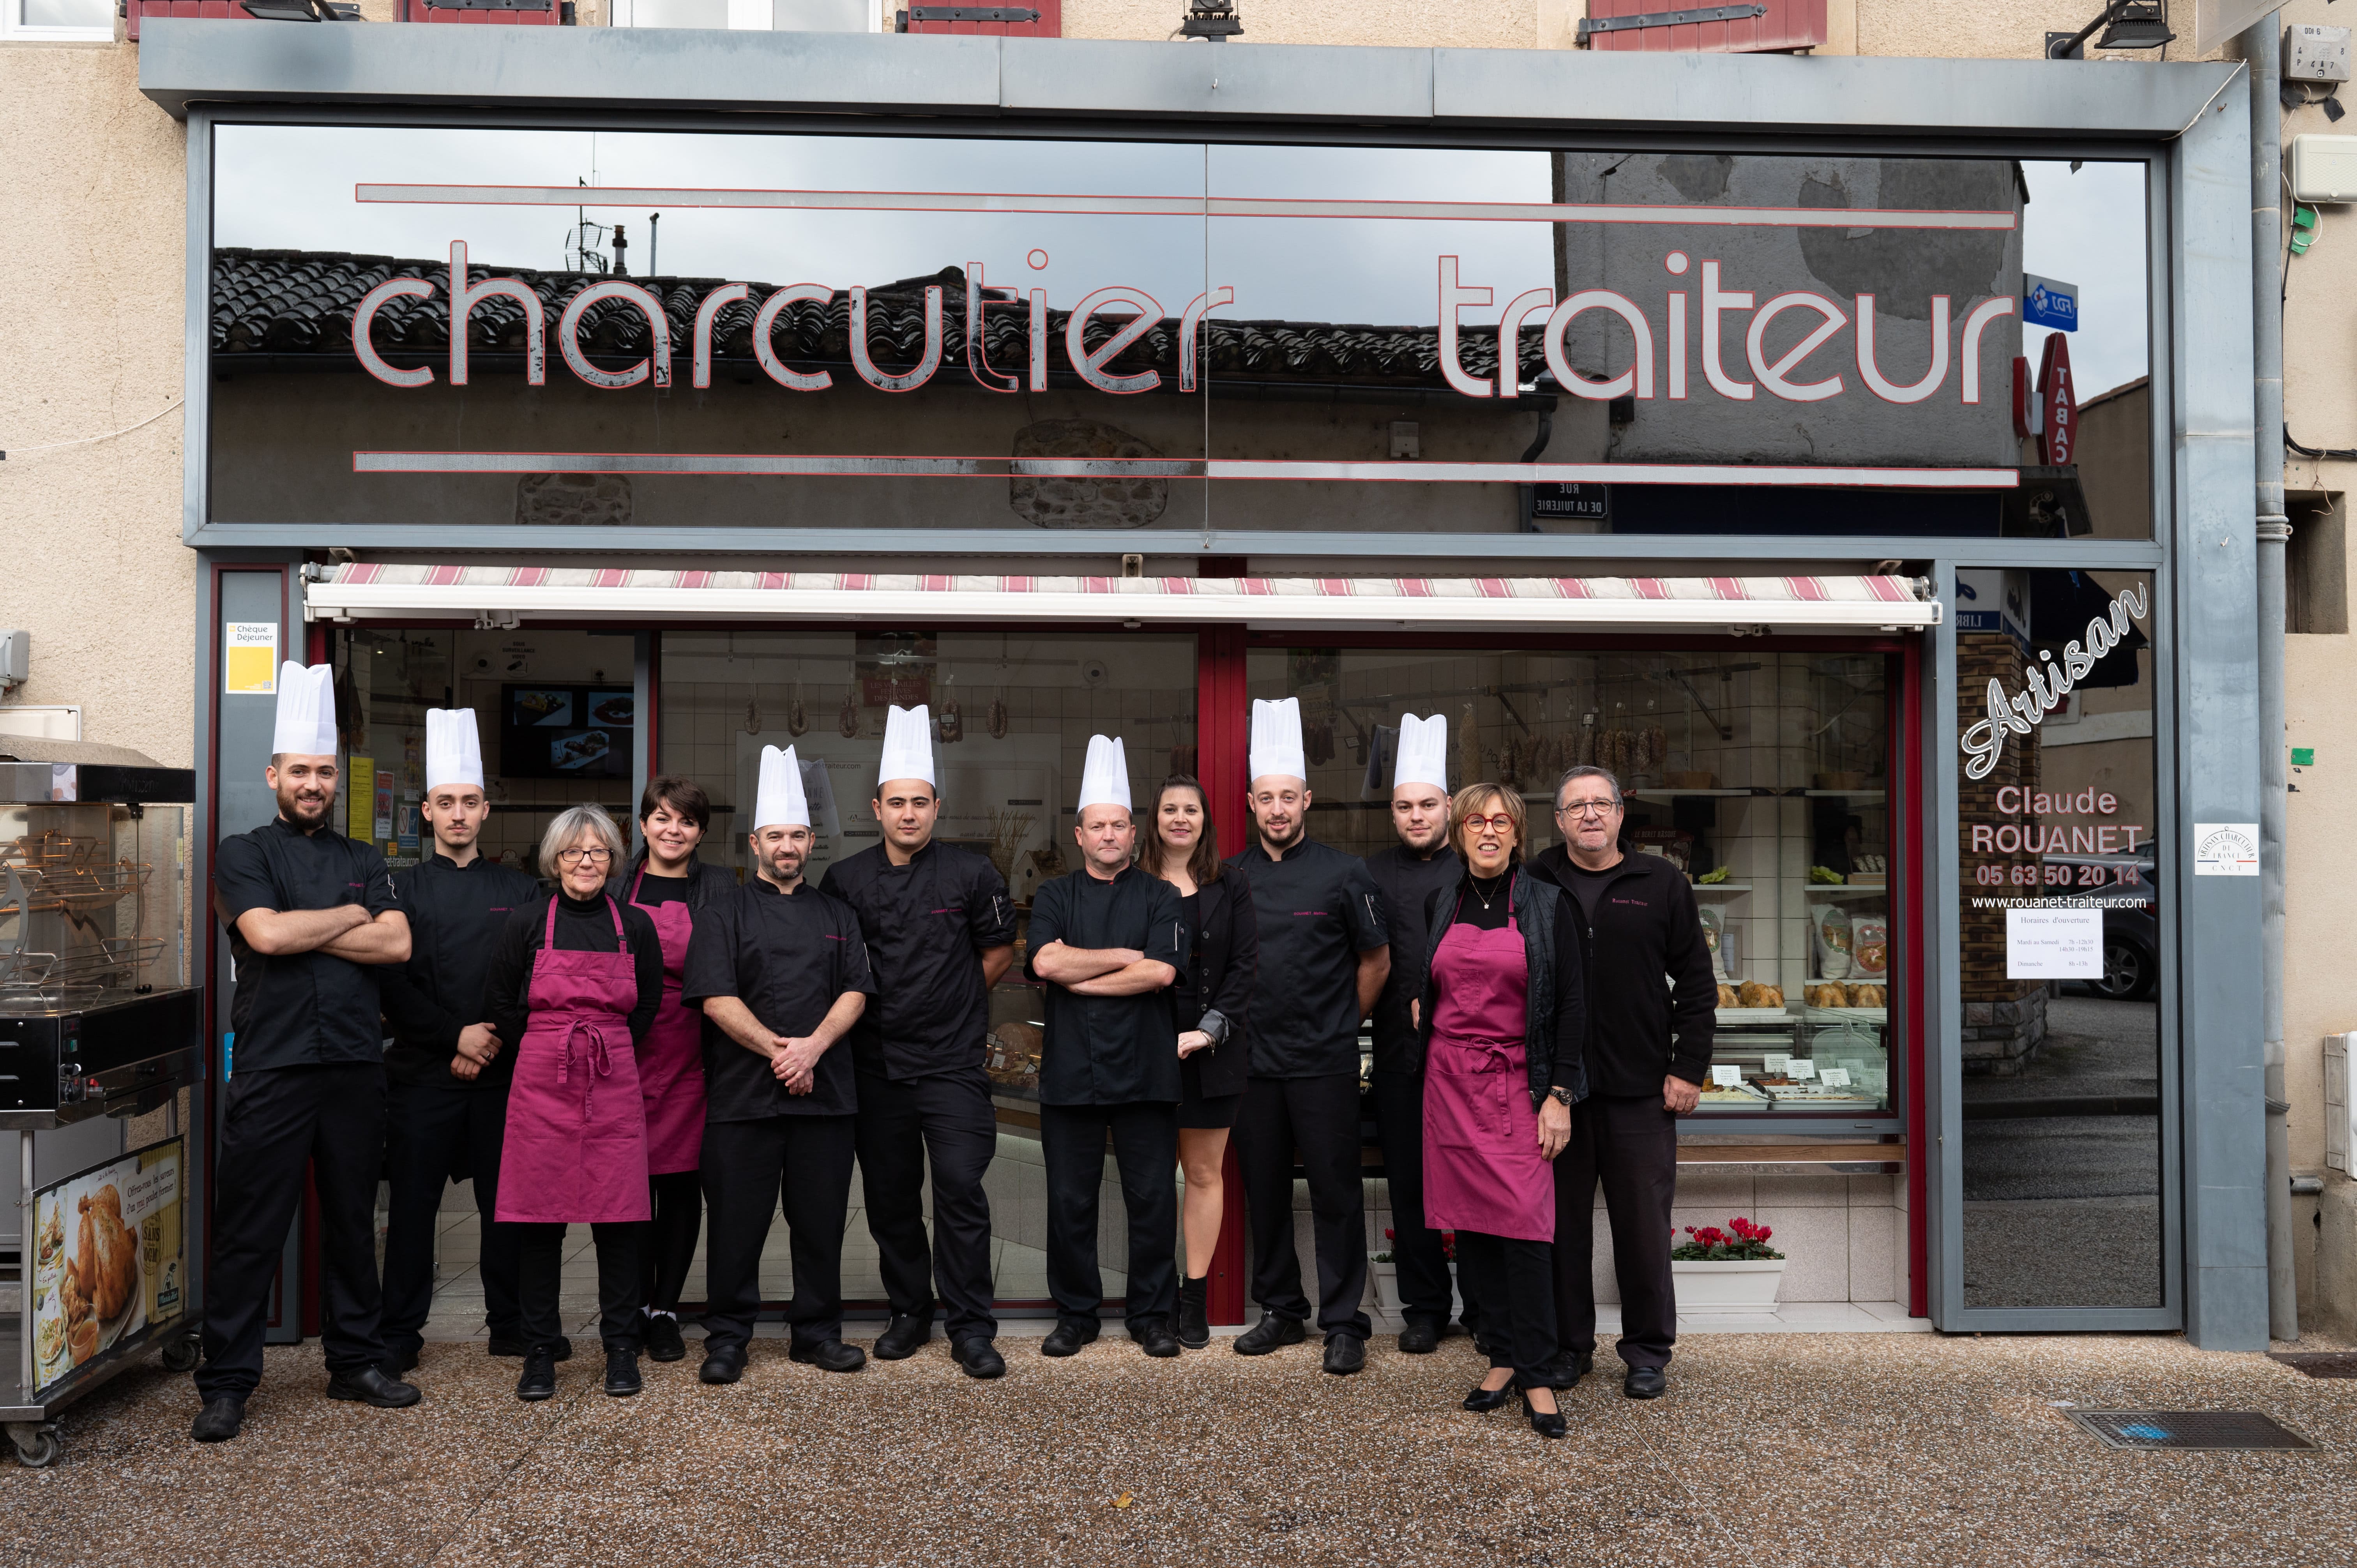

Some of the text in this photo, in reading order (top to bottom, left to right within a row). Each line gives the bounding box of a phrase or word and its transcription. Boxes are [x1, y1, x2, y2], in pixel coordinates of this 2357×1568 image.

[351, 239, 2016, 404] charcutier traiteur
[237, 625, 268, 633] Chèque
[237, 634, 273, 642] Déjeuner
[1961, 581, 2147, 780] Artisan
[1996, 786, 2118, 815] Claude
[1972, 825, 2143, 853] ROUANET
[2200, 833, 2255, 858] ARTISAN CHARCUTIER
[1977, 865, 2139, 886] 05 63 50 20 14
[1972, 896, 2147, 909] www.rouanet-traiteur.com
[127, 1180, 151, 1197] Offrez-vous
[160, 1168, 174, 1181] saveurs
[127, 1203, 135, 1214] d'un
[146, 1190, 157, 1205] poulet
[159, 1183, 173, 1196] fermier
[143, 1226, 160, 1242] SANS
